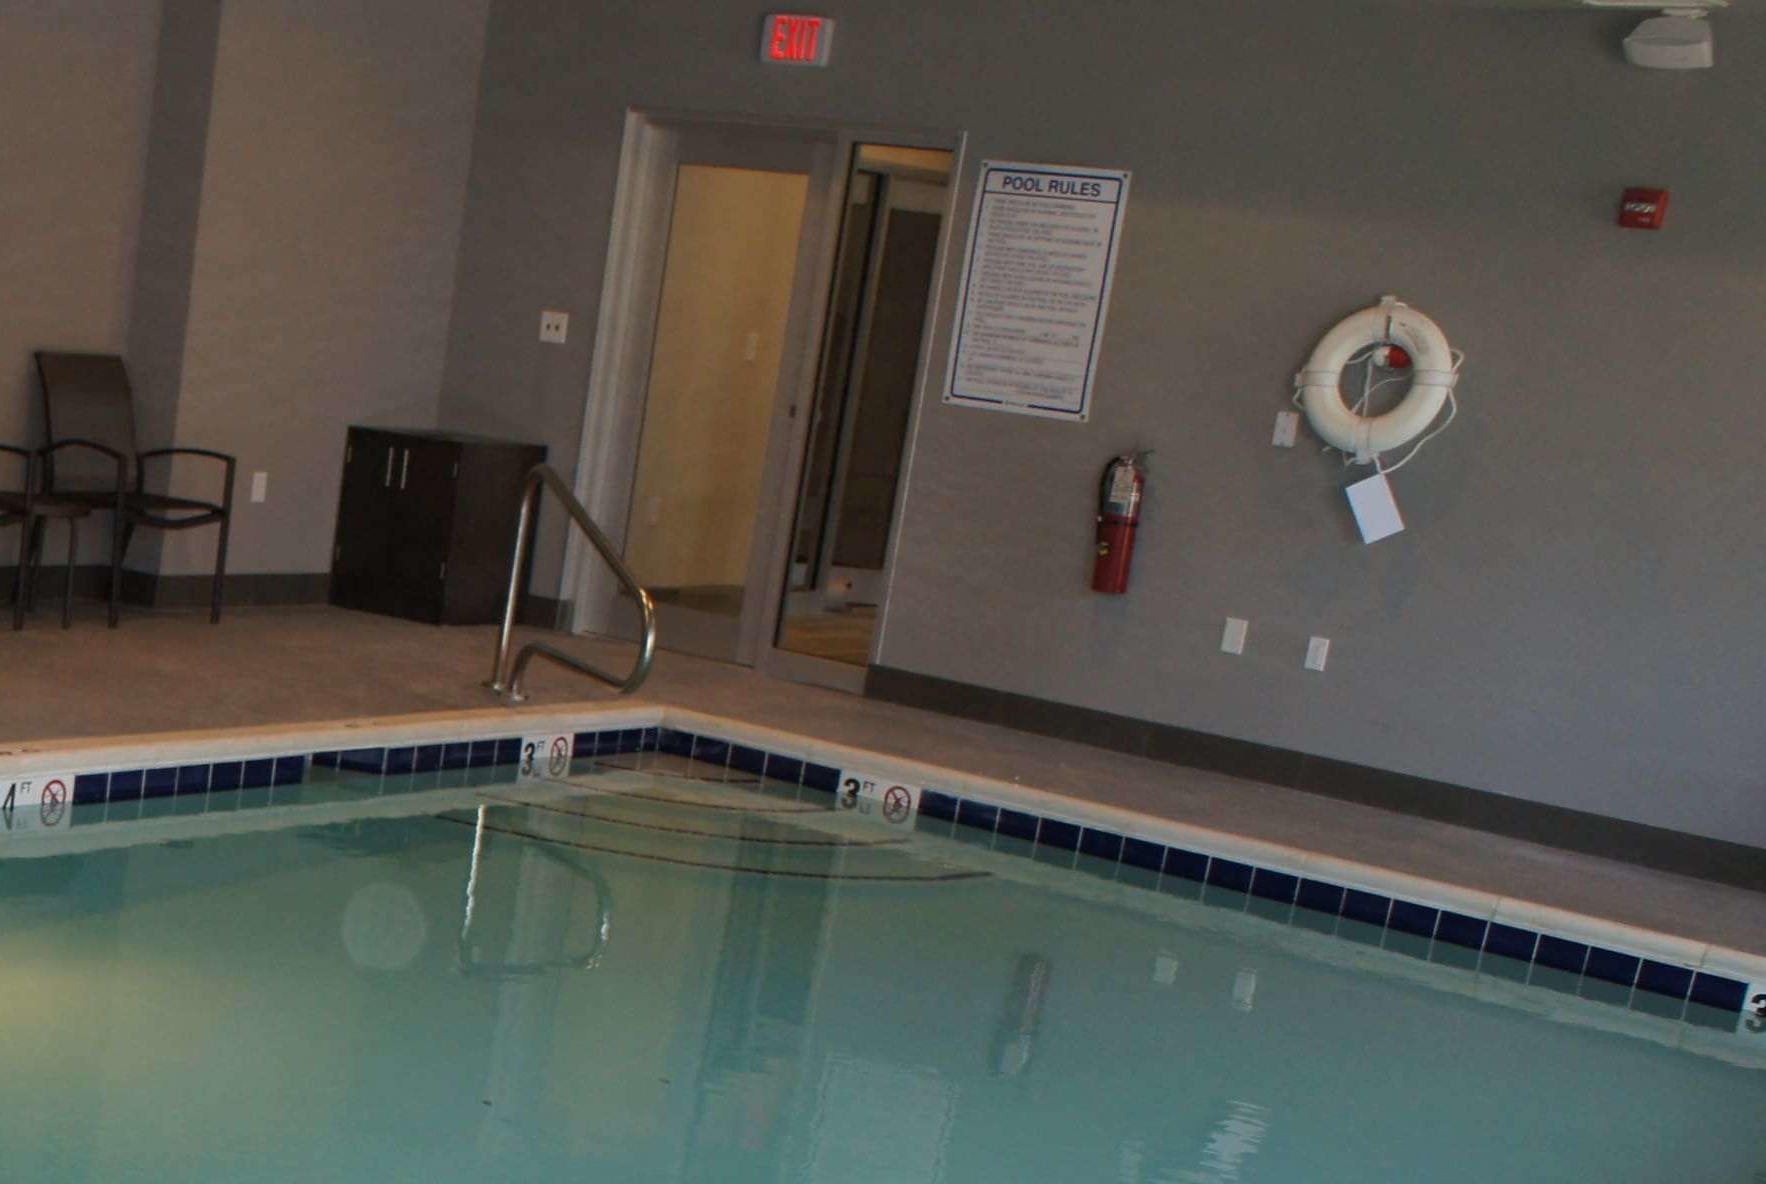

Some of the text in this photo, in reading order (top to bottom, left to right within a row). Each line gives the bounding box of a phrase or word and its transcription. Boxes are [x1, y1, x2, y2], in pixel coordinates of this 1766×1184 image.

[769, 15, 822, 62] EXIT
[1001, 174, 1102, 198] POOL RULES
[20, 781, 33, 795] FT
[862, 780, 875, 794] FT
